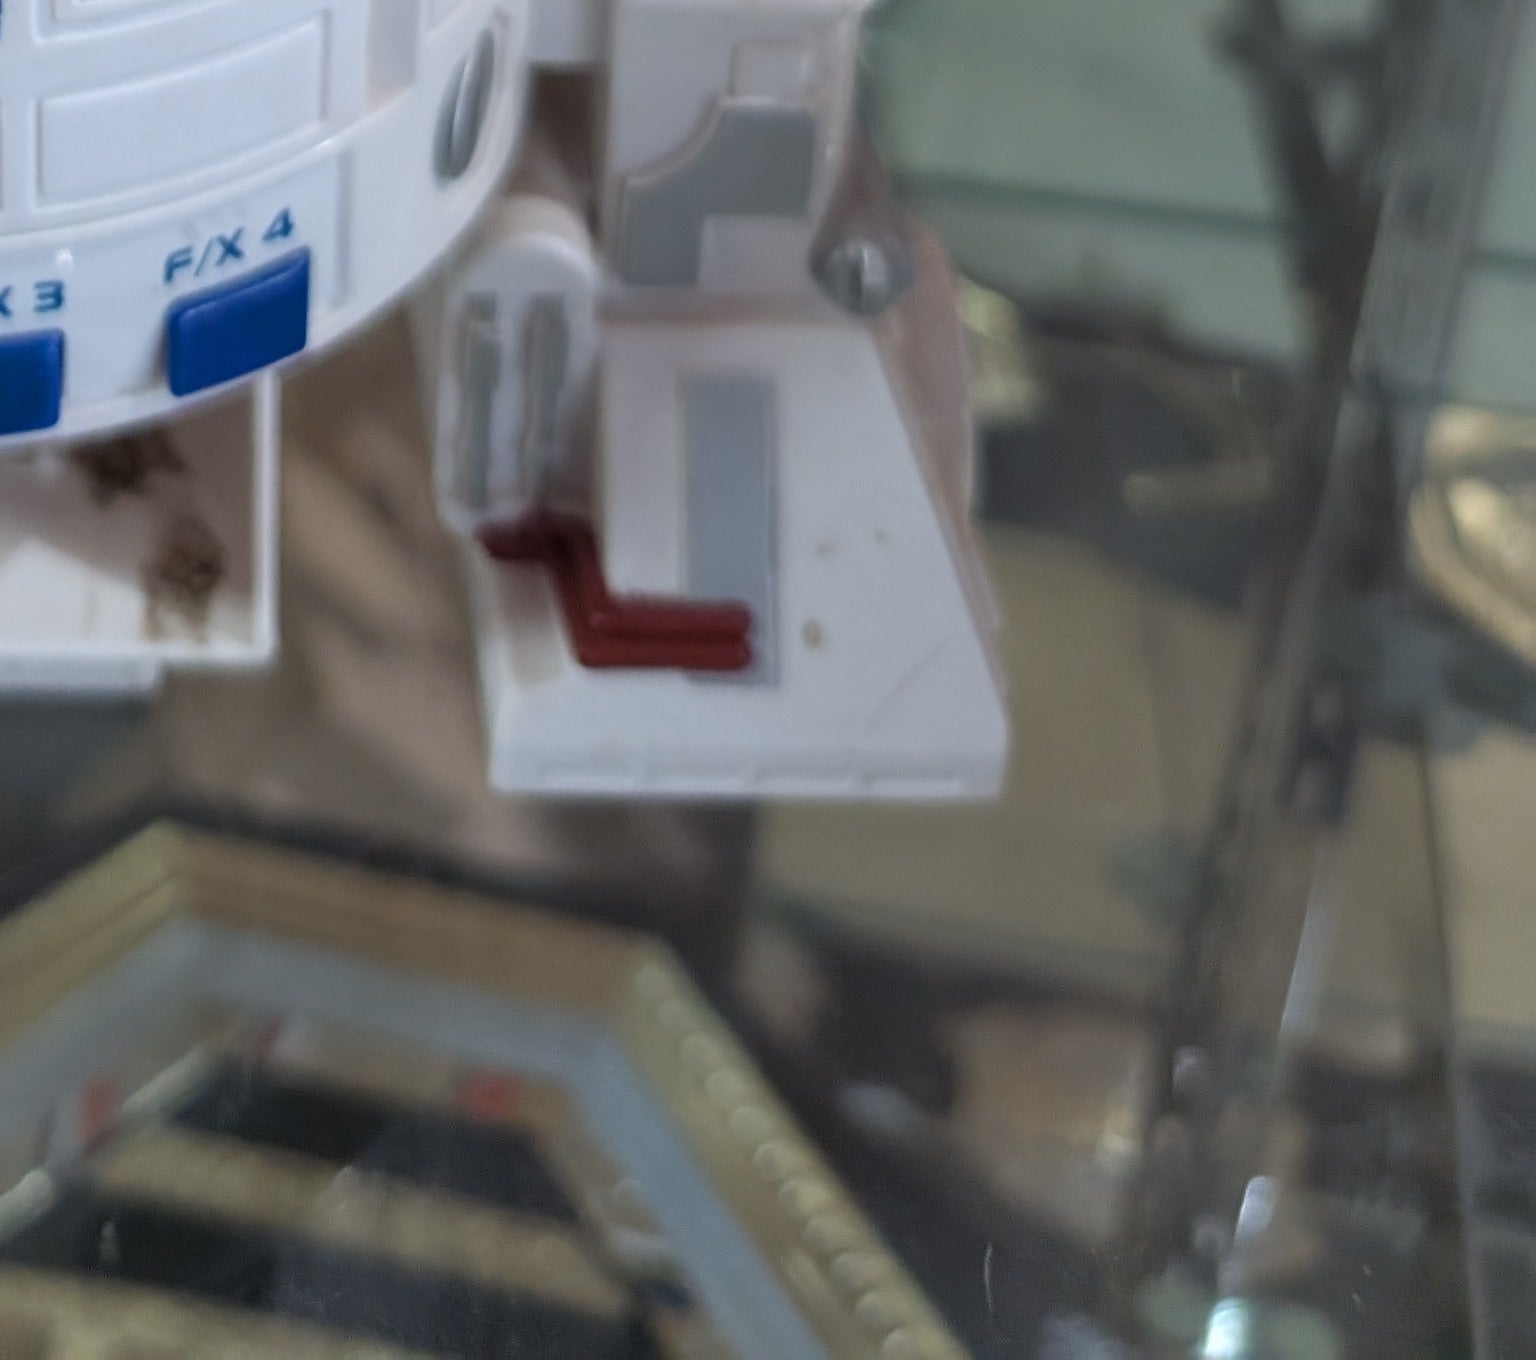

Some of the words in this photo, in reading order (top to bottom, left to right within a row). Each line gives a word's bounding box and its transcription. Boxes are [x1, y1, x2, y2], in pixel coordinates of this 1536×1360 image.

[164, 227, 244, 284] F/X
[262, 206, 295, 244] 4
[33, 280, 66, 313] 3
